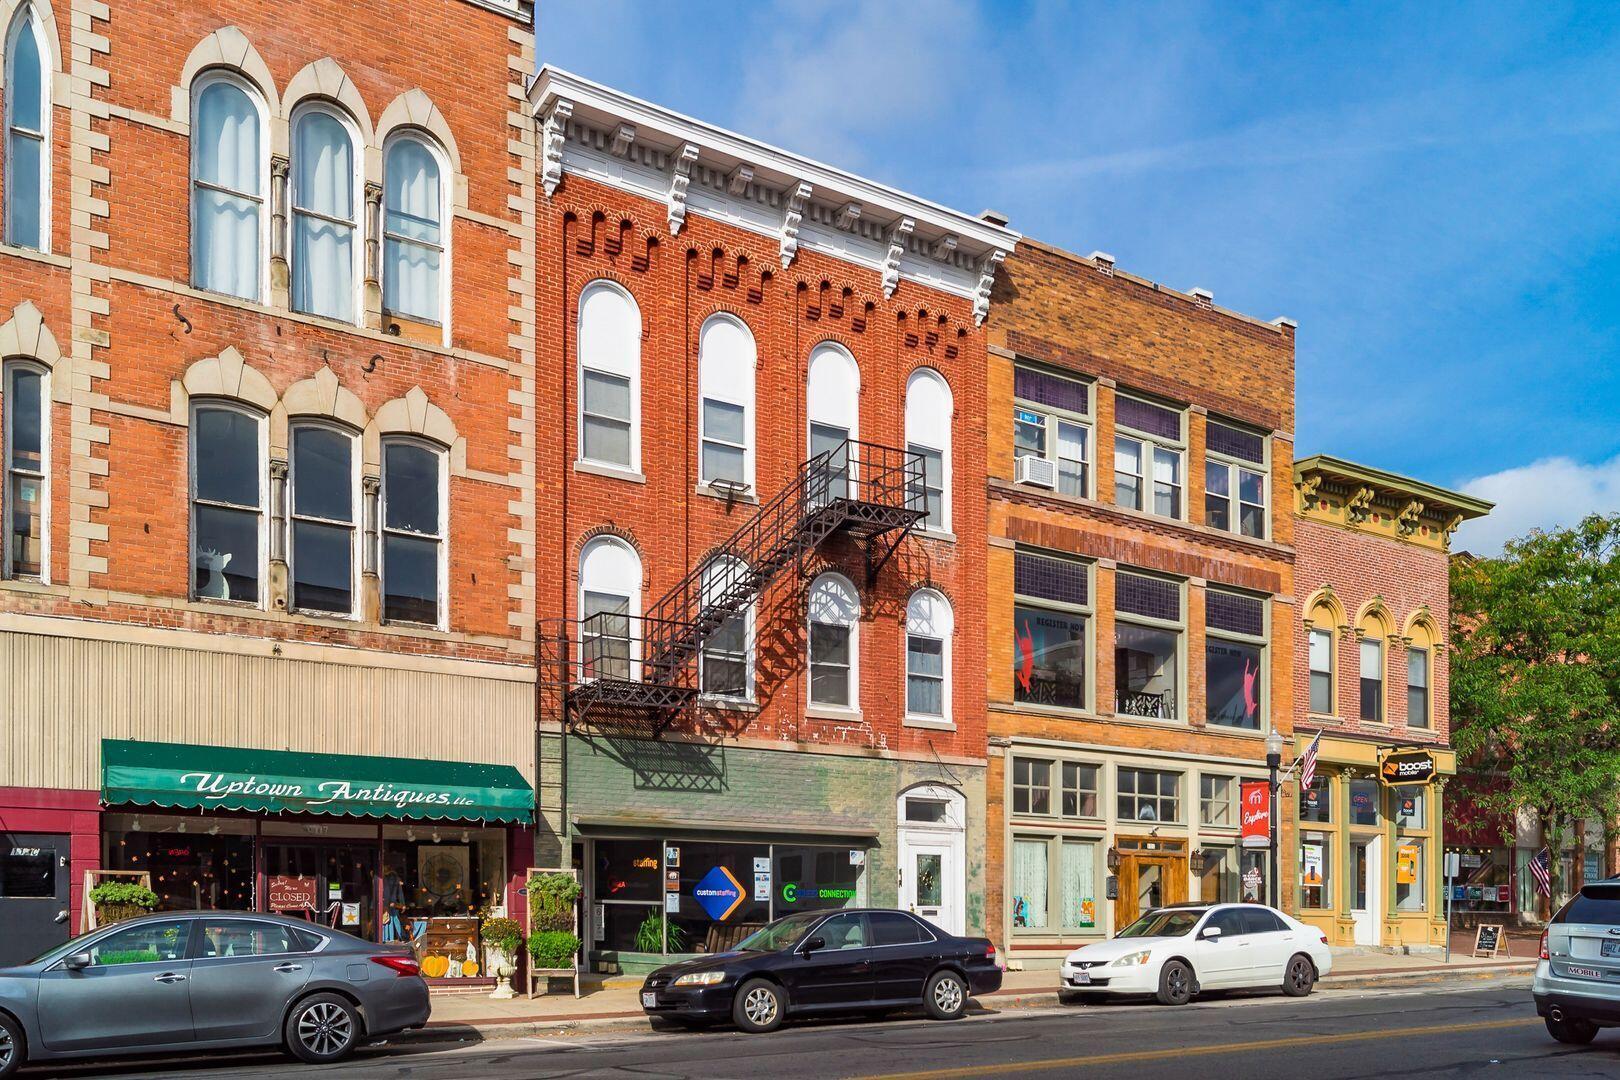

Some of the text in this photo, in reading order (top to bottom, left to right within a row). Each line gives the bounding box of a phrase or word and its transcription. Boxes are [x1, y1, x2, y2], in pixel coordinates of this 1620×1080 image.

[1036, 617, 1068, 630] REGISTER
[1399, 760, 1432, 771] boost
[180, 773, 303, 799] Uptown
[269, 892, 310, 902] CLOSED
[819, 889, 857, 898] CONNECTION
[1569, 967, 1601, 978] MOBILE
